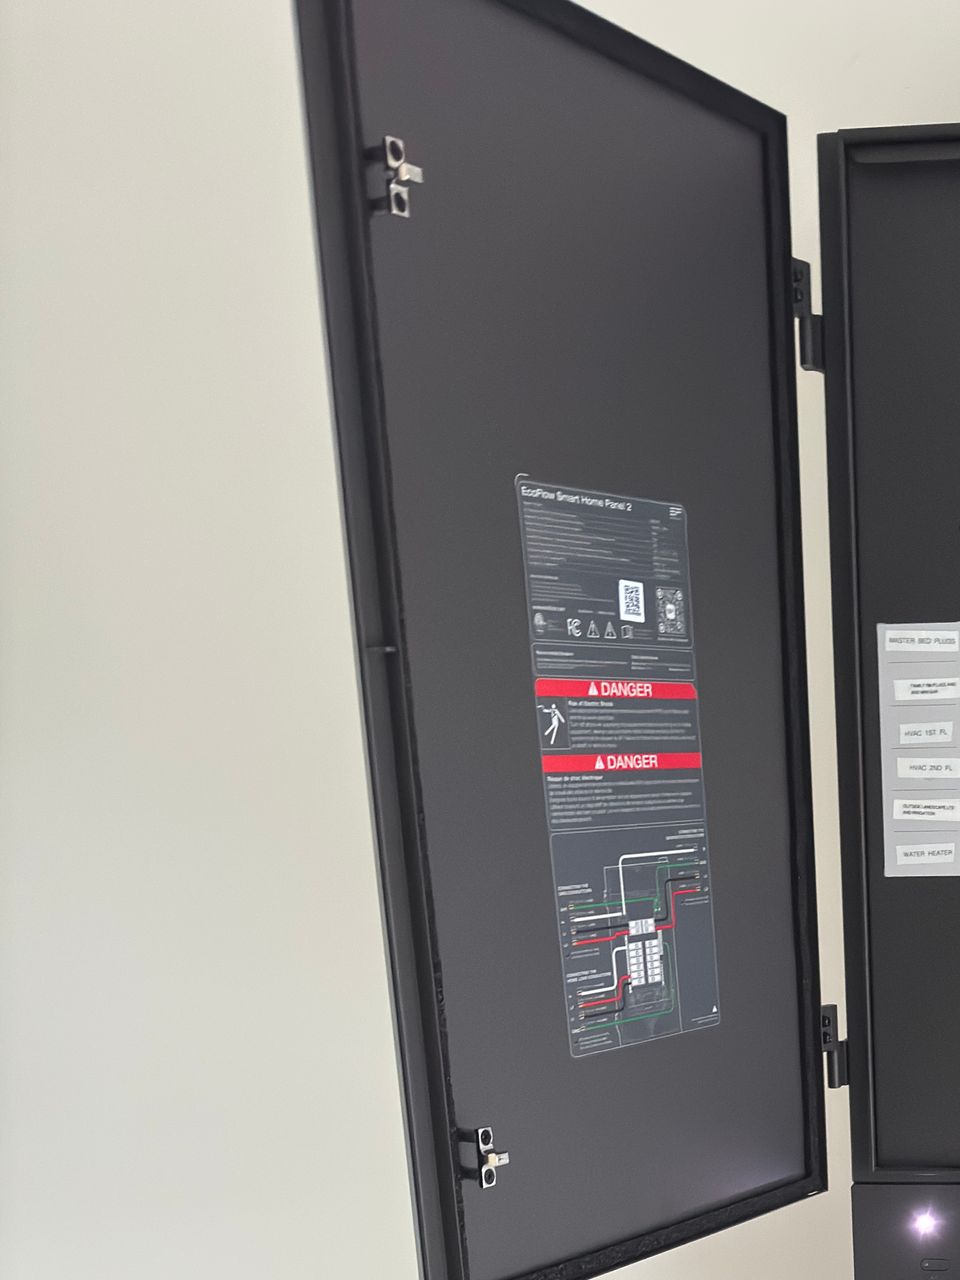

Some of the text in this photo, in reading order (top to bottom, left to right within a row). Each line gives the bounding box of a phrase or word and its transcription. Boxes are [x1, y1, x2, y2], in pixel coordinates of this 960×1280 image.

[521, 486, 633, 511] EcoFlow Smart Home Panel 2
[600, 682, 653, 697] DANGER
[607, 754, 658, 769] DANGER
[928, 849, 953, 857] HEATER
